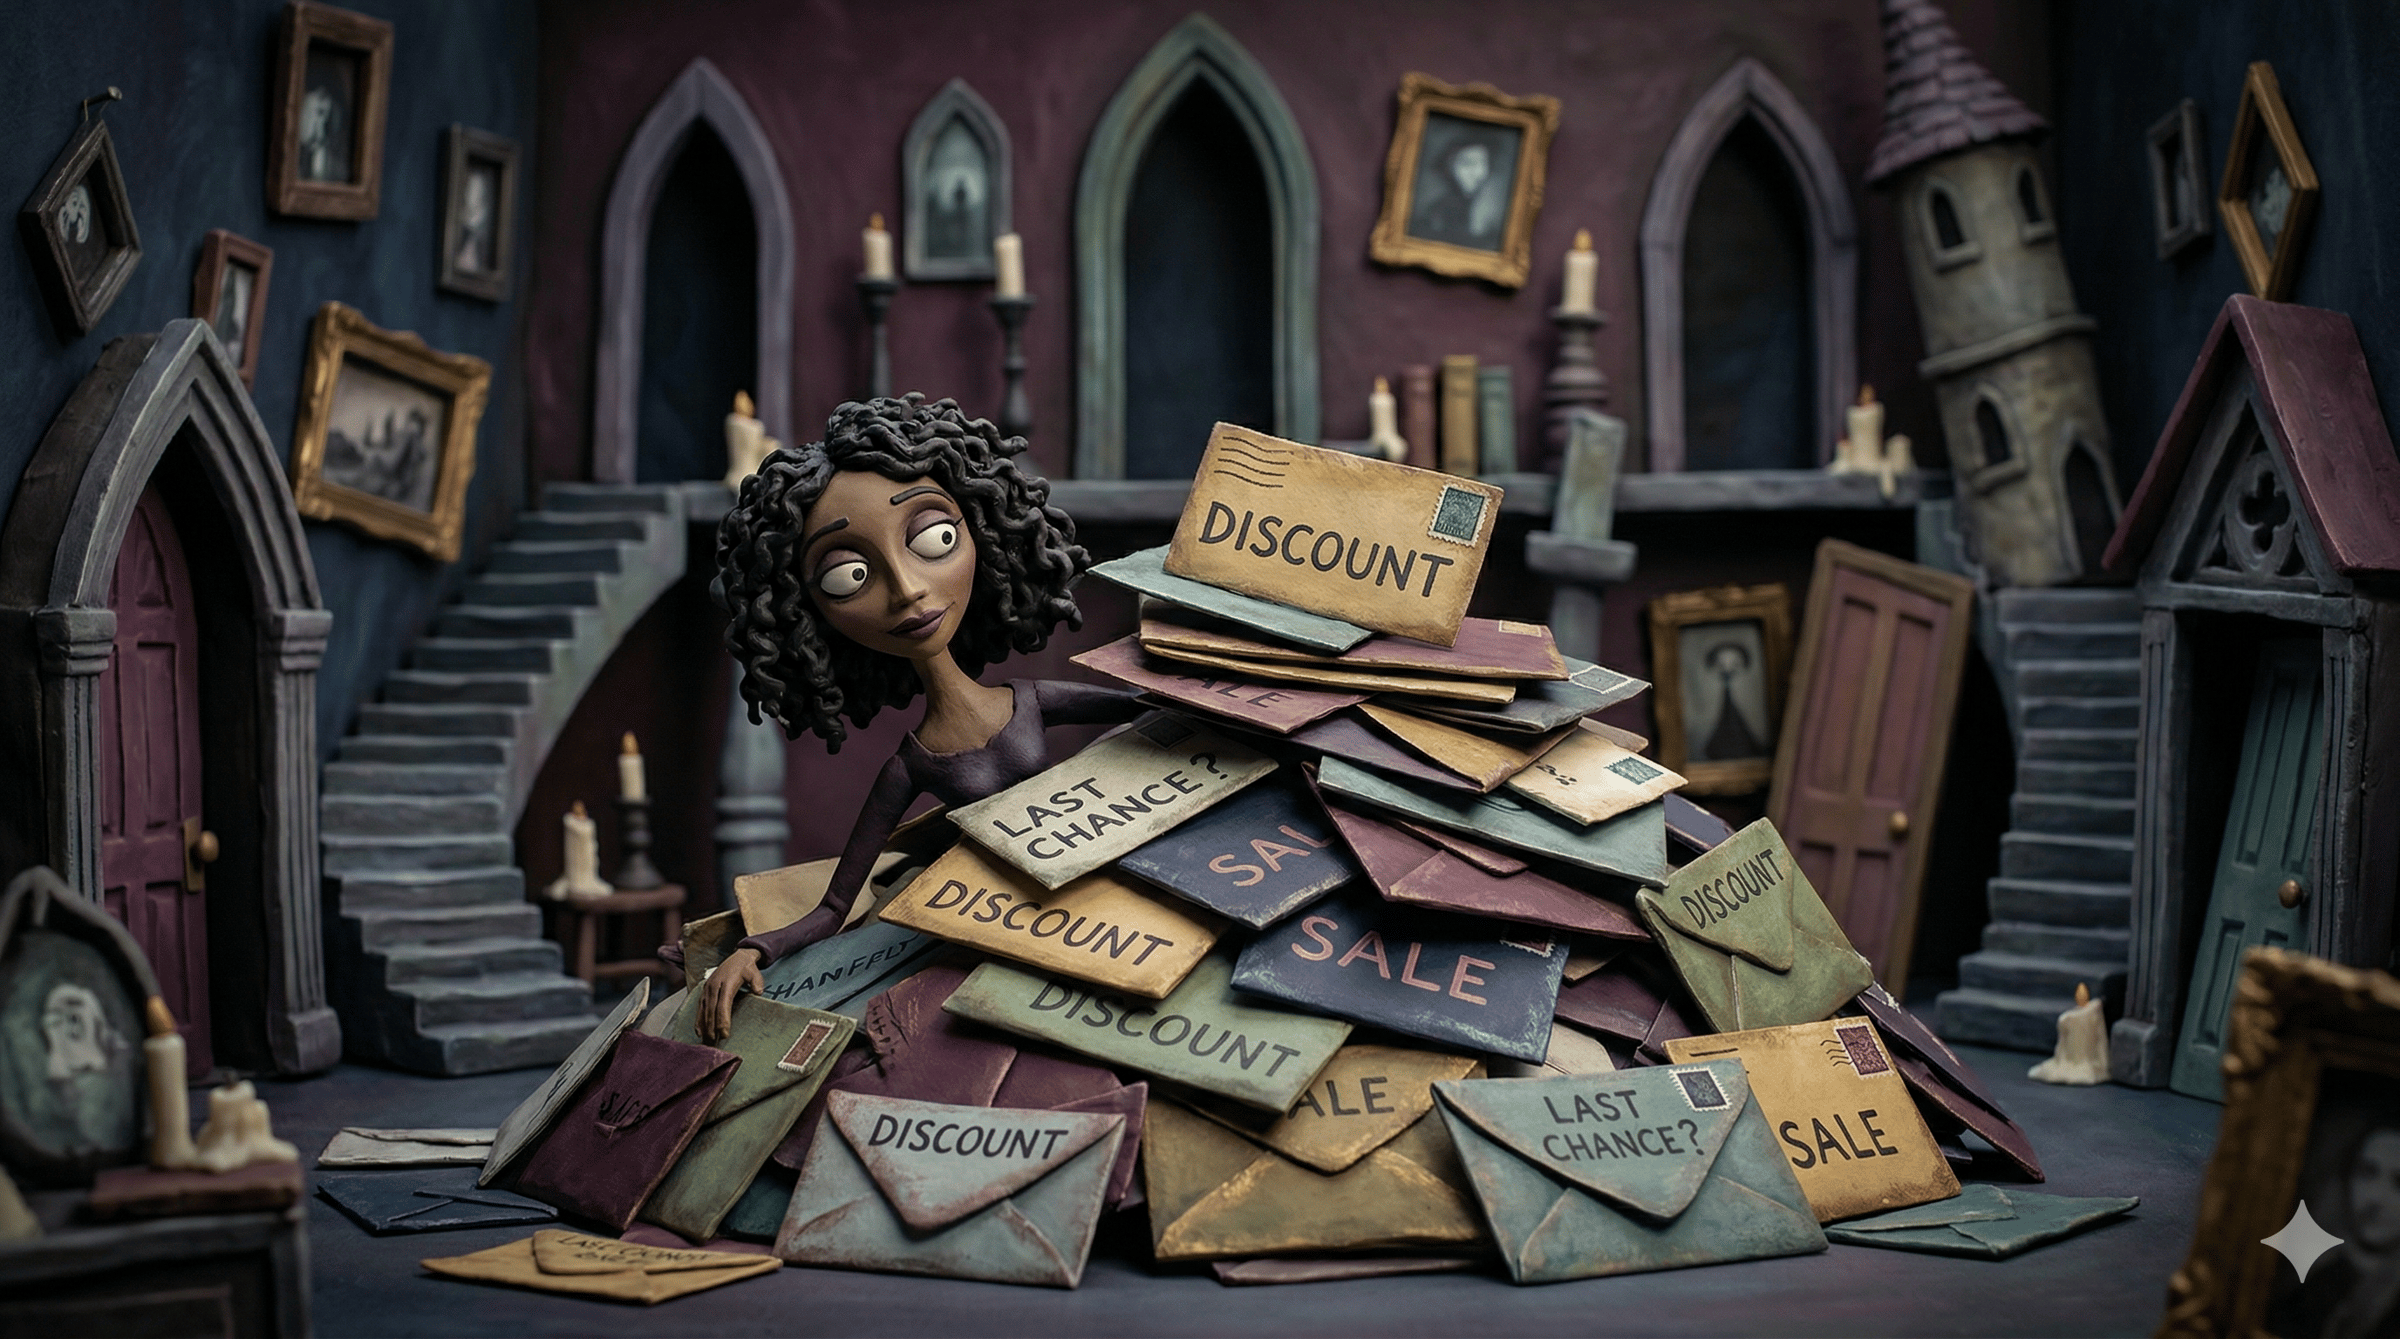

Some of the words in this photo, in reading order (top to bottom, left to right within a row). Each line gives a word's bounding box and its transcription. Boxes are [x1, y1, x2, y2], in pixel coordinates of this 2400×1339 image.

[1199, 501, 1455, 598] DISCOUNT
[1176, 675, 1294, 709] ALE
[992, 776, 1107, 839] LAST
[1026, 752, 1231, 861] CHANCE?
[1208, 824, 1335, 887] SAL
[1680, 848, 1784, 930] DISCOUNT
[924, 878, 1174, 967] DISCOUNT
[1291, 915, 1496, 1006] SALE
[1030, 979, 1301, 1078] DISCOUNT
[1287, 1075, 1395, 1120] ALE
[1543, 1089, 1640, 1124] LAST
[867, 1113, 1069, 1161] DISCOUNT
[1543, 1118, 1705, 1162] CHANCE?
[1778, 1109, 1899, 1169] SALE
